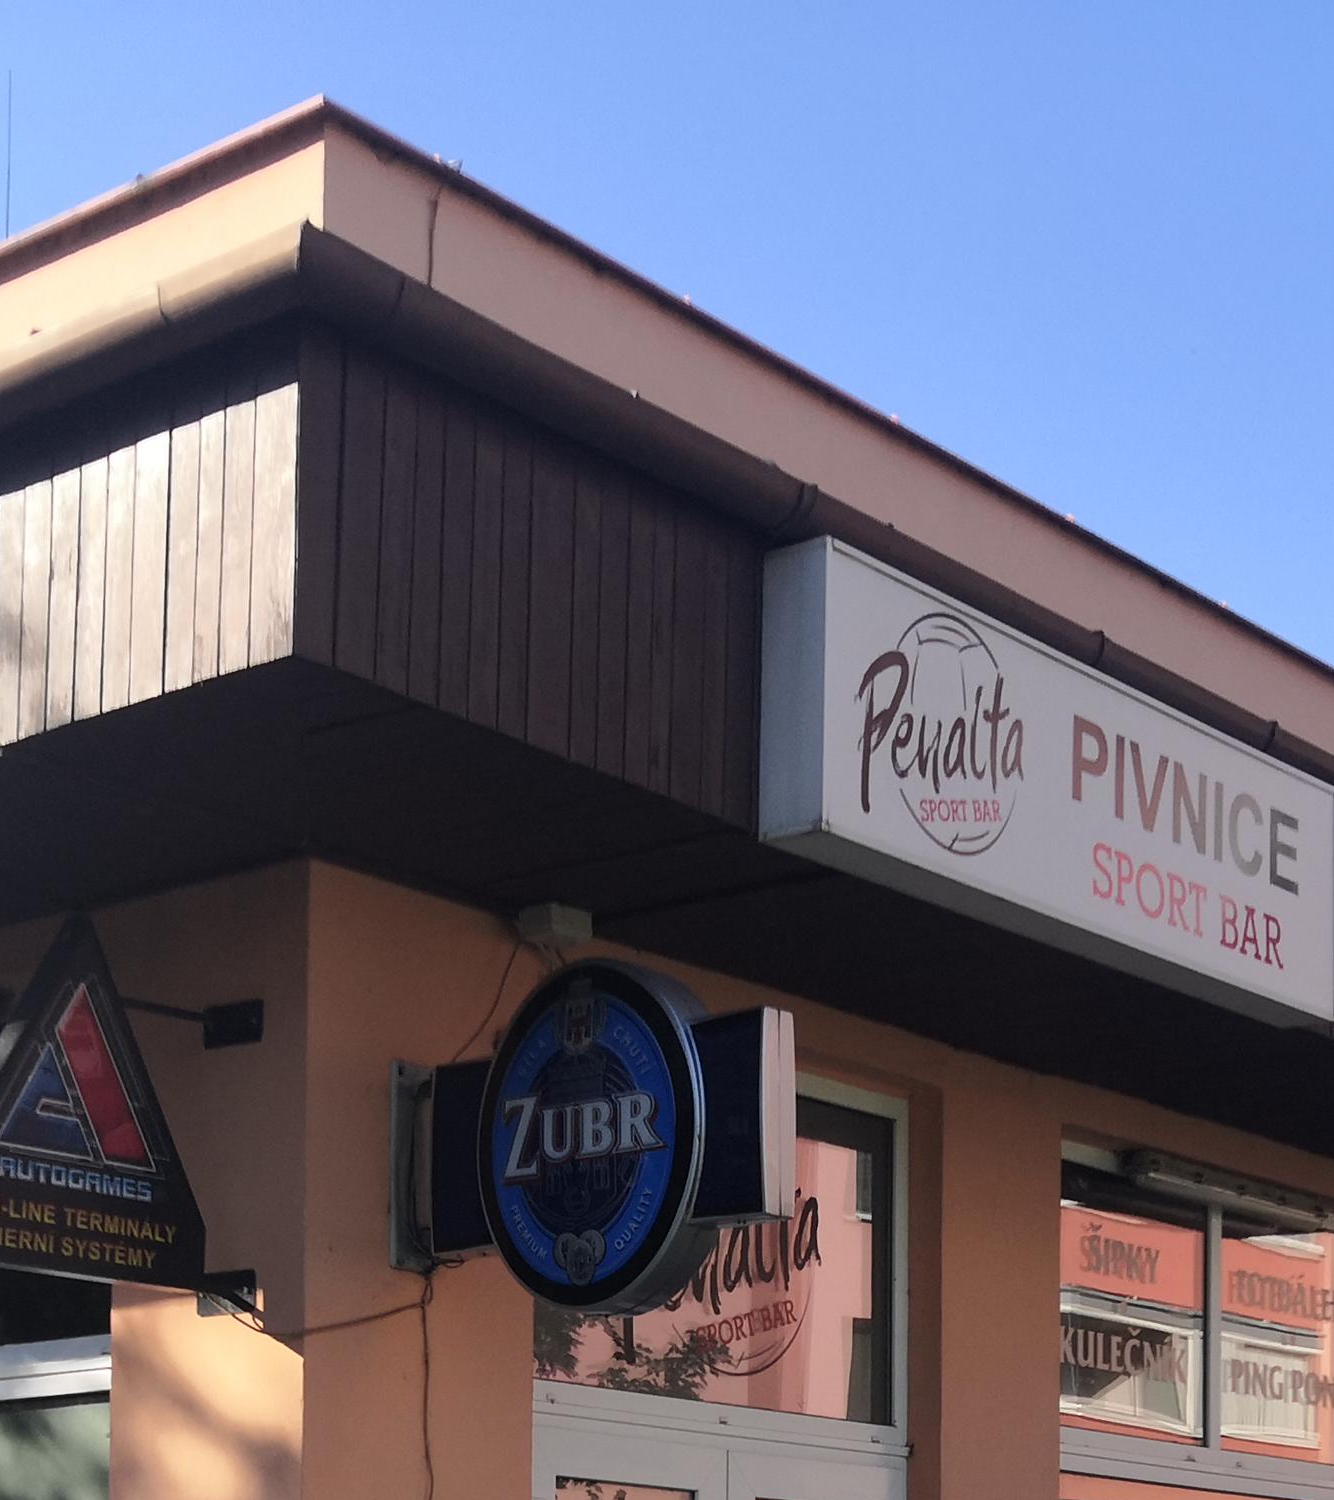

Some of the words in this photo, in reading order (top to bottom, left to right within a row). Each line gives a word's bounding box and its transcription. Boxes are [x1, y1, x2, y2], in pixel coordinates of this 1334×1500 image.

[854, 650, 1024, 813] Penalta
[918, 797, 967, 823] SPORT
[972, 799, 1003, 823] BAR
[1071, 713, 1299, 895] PIVNICE
[1091, 842, 1207, 938] SPORT
[1219, 896, 1284, 970] BAR
[502, 1091, 667, 1185] ZUBR
[510, 1204, 548, 1260] PREMIUM
[613, 1187, 653, 1251] QUALITY
[759, 1299, 798, 1334] BAR
[1229, 1357, 1284, 1402] PING
